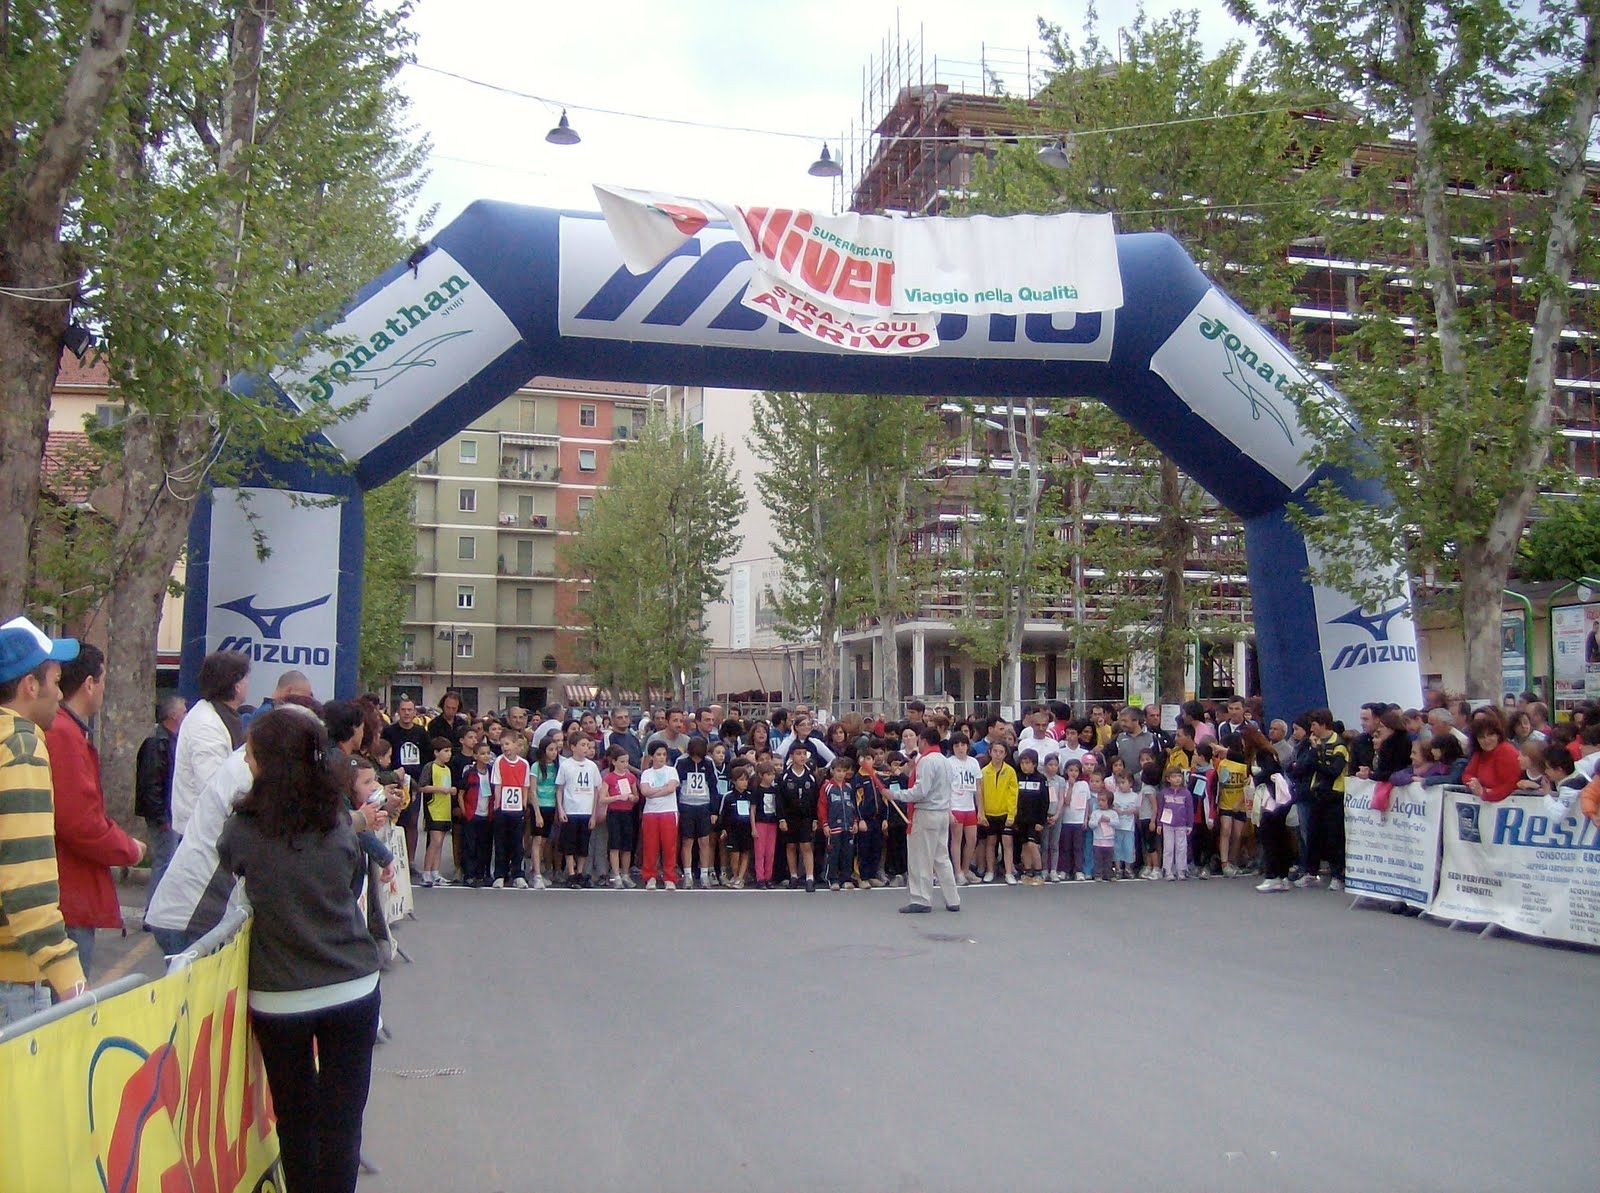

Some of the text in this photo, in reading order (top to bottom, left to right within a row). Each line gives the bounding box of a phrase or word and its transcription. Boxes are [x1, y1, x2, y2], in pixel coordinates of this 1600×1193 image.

[904, 284, 1079, 304] Viaggio nella Qualità
[772, 286, 917, 334] STRA-ACQUI
[751, 293, 930, 348] ARRIVO
[307, 274, 469, 402] Jonathan
[1329, 643, 1416, 670] MIZUNO
[577, 771, 589, 787] 44
[690, 774, 703, 789] 32
[960, 770, 975, 785] 146
[506, 788, 519, 804] 25
[1391, 797, 1427, 818] Acqui
